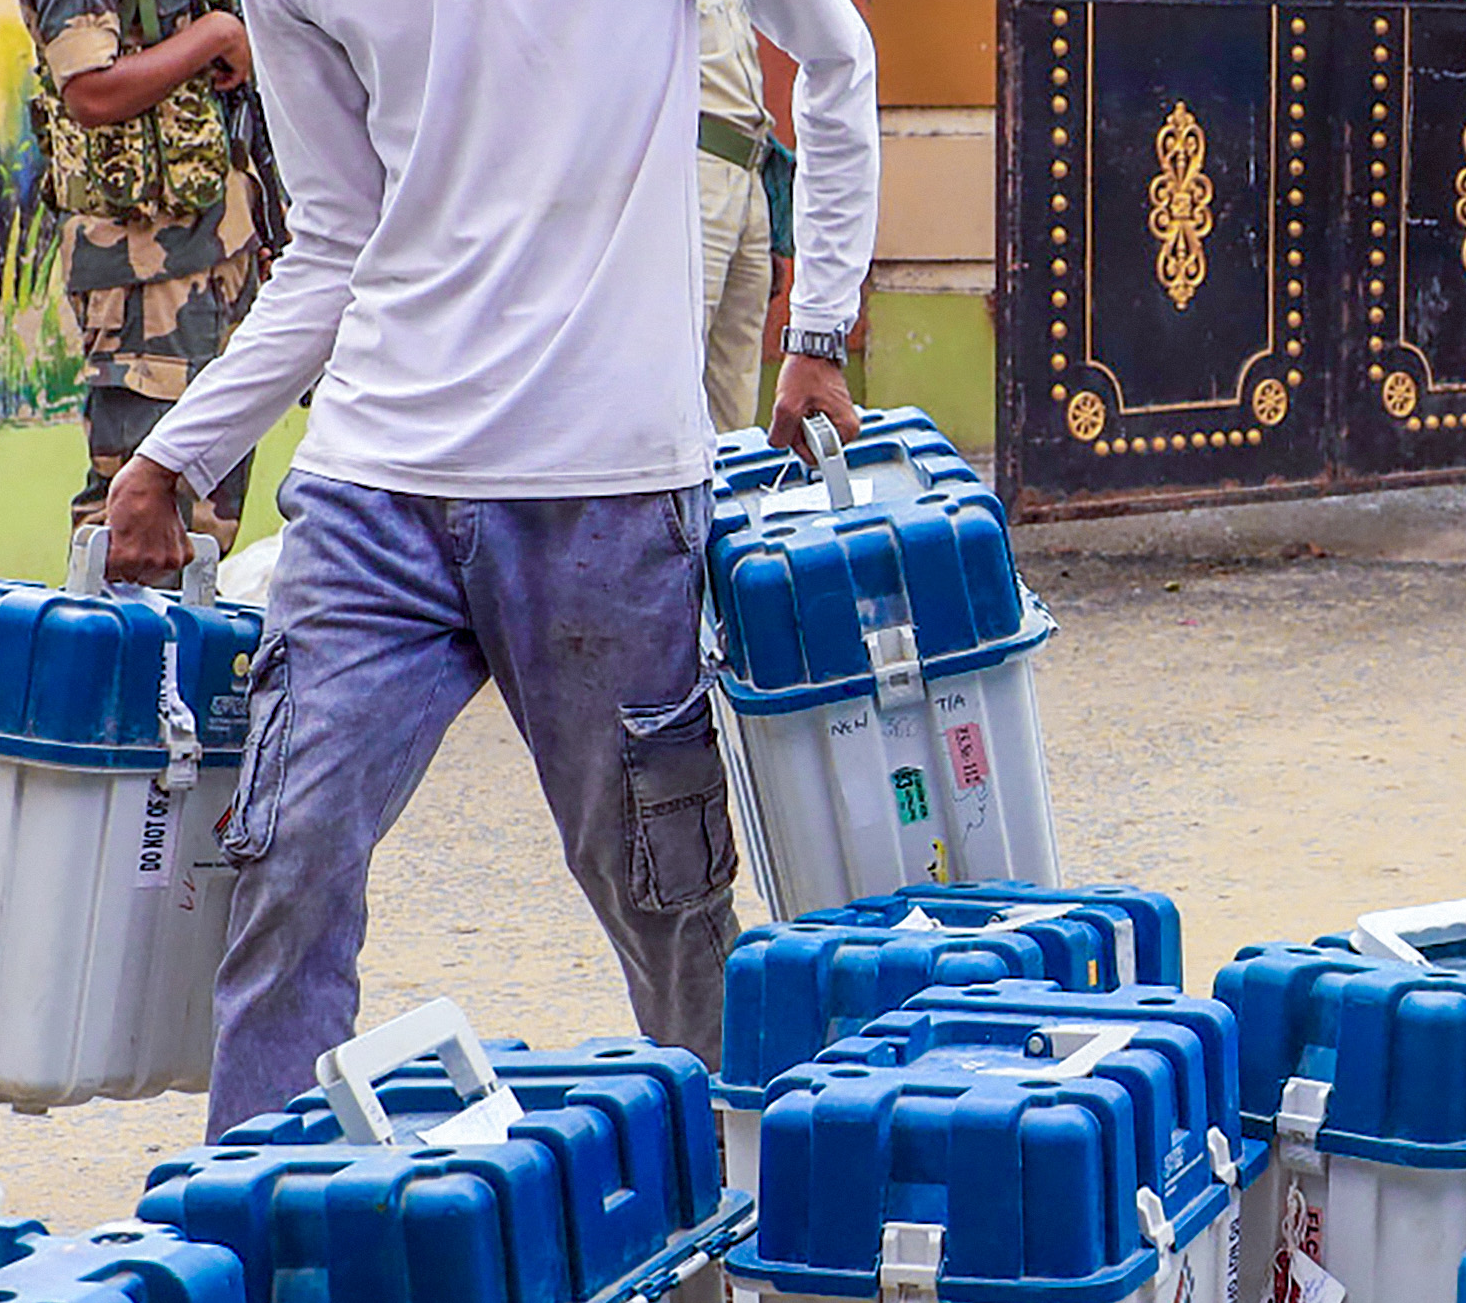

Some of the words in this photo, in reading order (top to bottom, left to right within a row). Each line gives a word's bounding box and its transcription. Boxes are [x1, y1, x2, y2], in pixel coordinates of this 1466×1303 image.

[831, 711, 868, 736] NEW
[142, 820, 166, 850] NOT
[140, 852, 162, 872] DO
